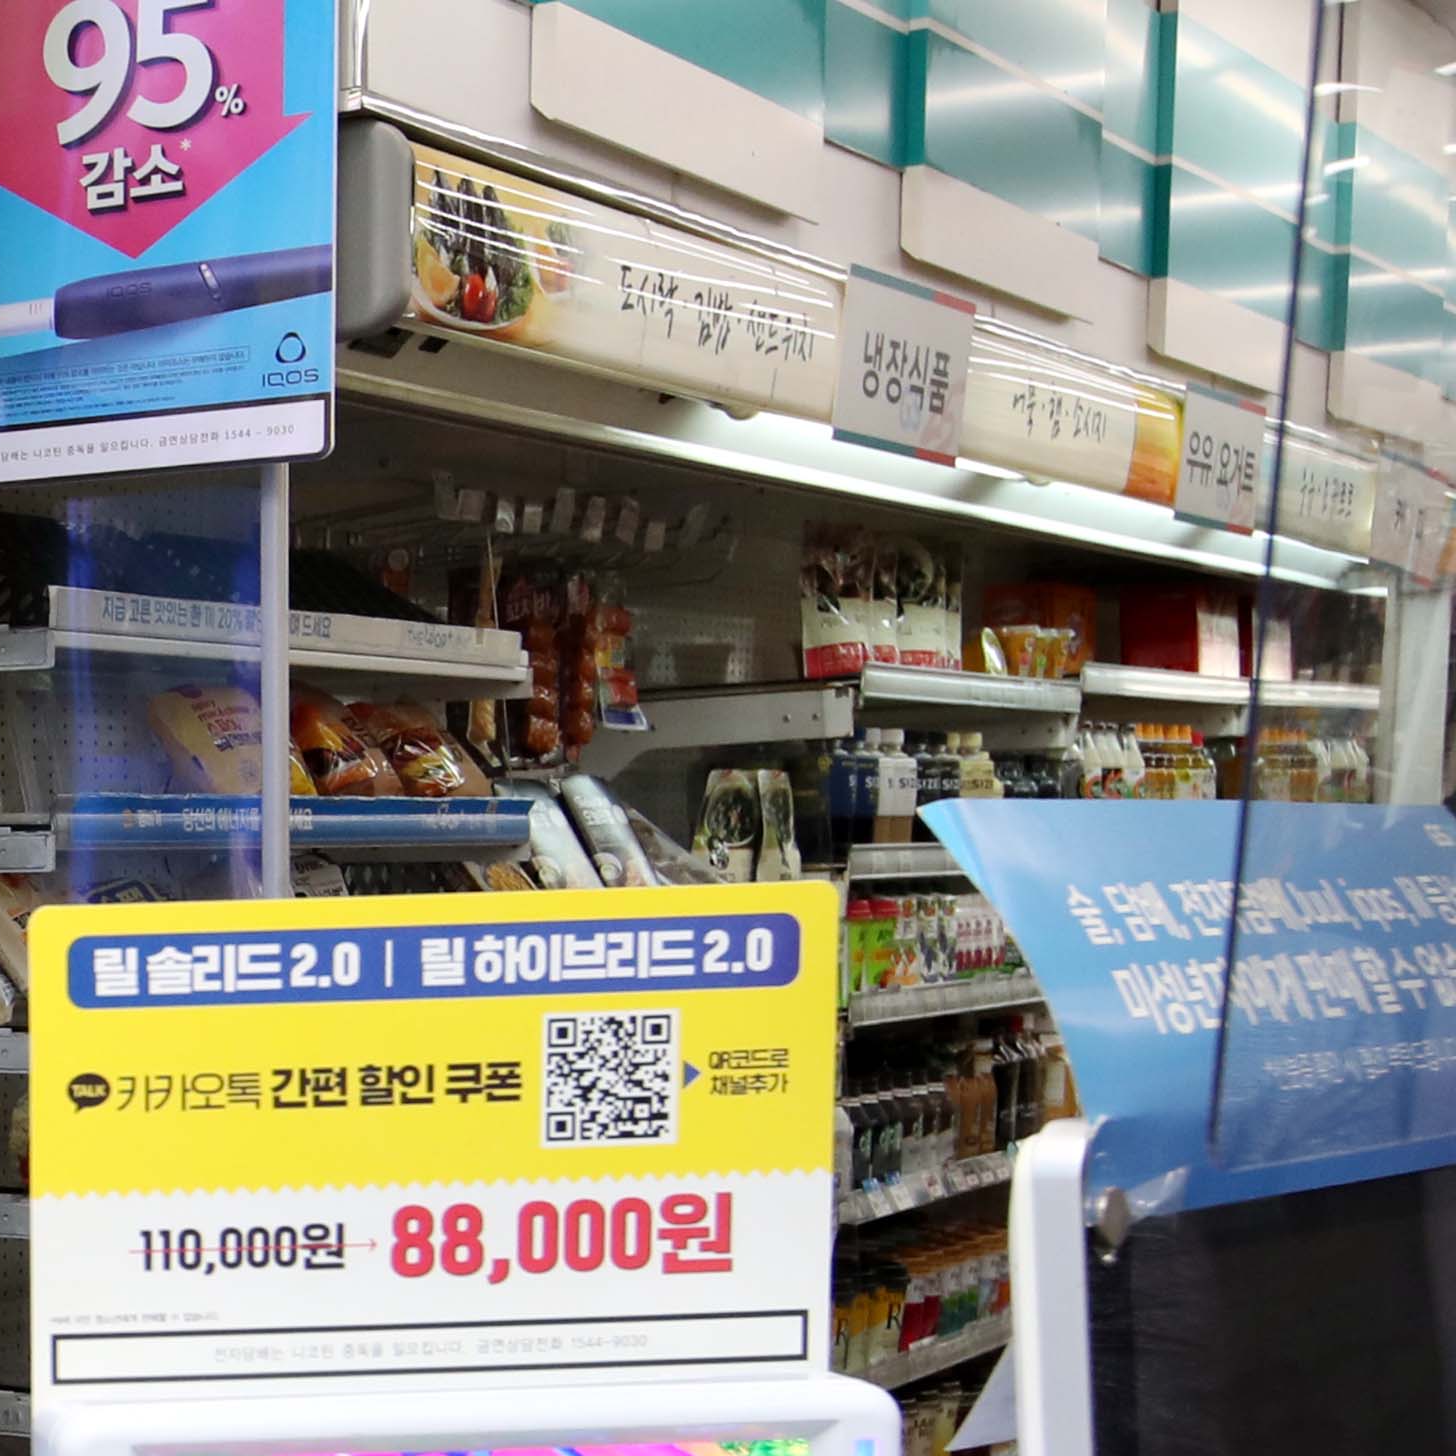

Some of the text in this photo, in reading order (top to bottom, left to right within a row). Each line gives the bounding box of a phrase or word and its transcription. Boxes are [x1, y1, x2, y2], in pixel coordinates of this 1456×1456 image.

[261, 368, 319, 389] IQOS
[861, 330, 952, 415] 냉장식품
[224, 428, 251, 441] 1544
[267, 425, 295, 437] 9030
[93, 927, 773, 996] 릴 솔리드 2.0 릴 하이브리드 2.0
[709, 1048, 790, 1070] QR코드로
[117, 1061, 521, 1113] 카카오톡 간편 할인 쿠폰
[710, 1073, 789, 1095] 채널추가
[139, 1191, 734, 1285] 110,000원 88,000원
